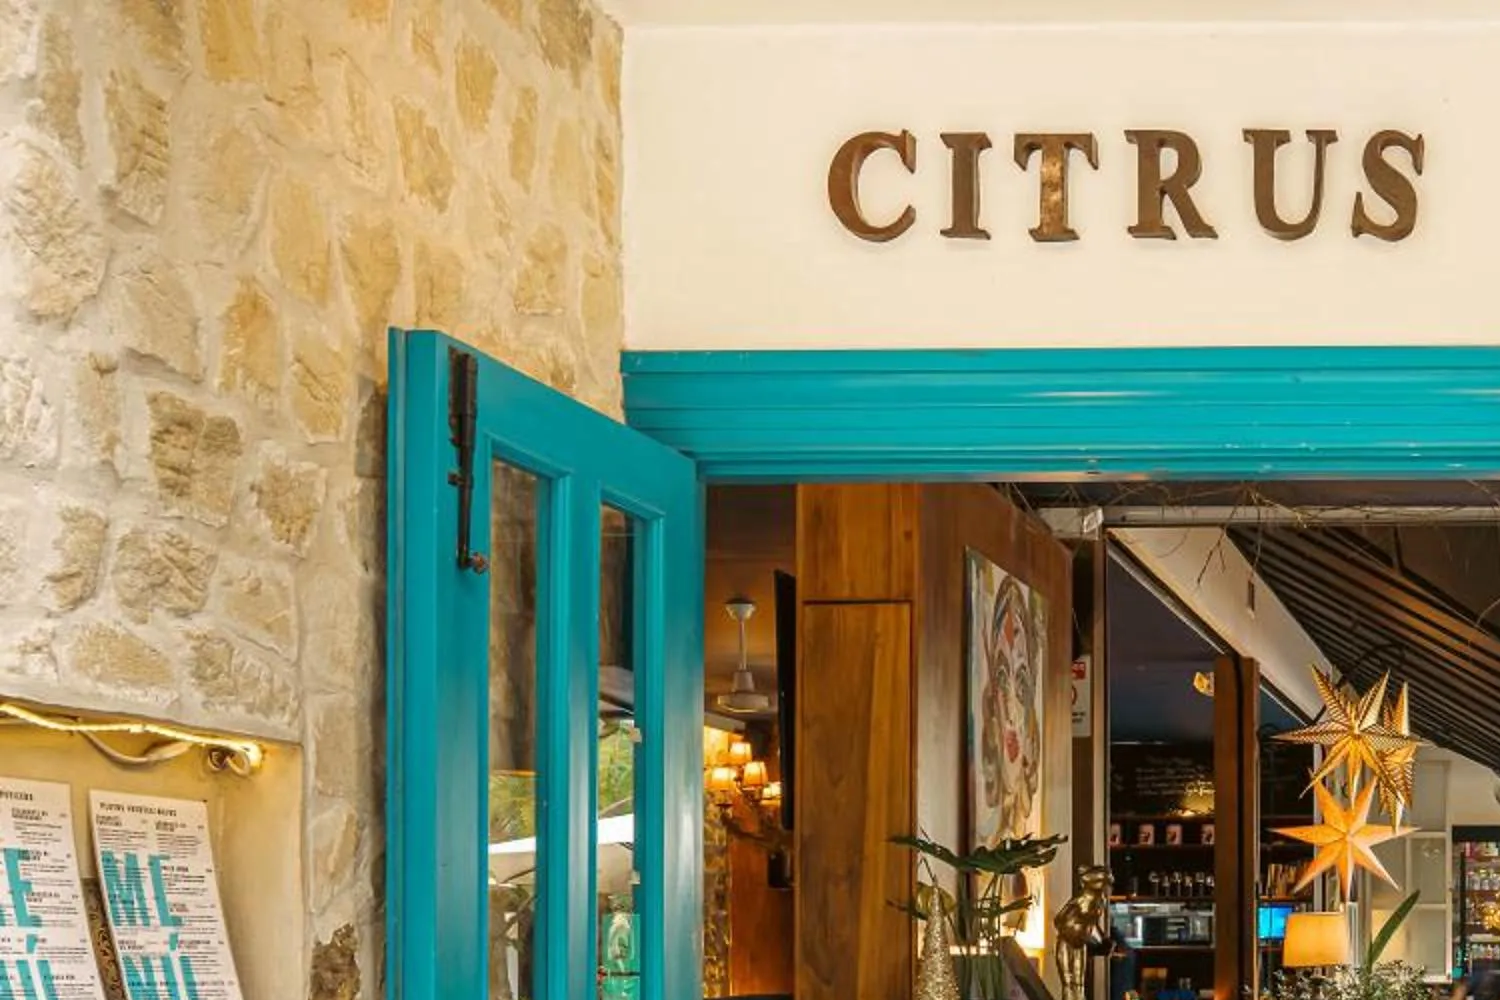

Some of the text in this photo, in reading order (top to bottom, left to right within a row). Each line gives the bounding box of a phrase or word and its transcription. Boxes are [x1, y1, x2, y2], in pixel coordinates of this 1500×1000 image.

[828, 128, 1426, 243] CITRUS
[0, 848, 42, 928] E
[102, 851, 183, 928] ME
